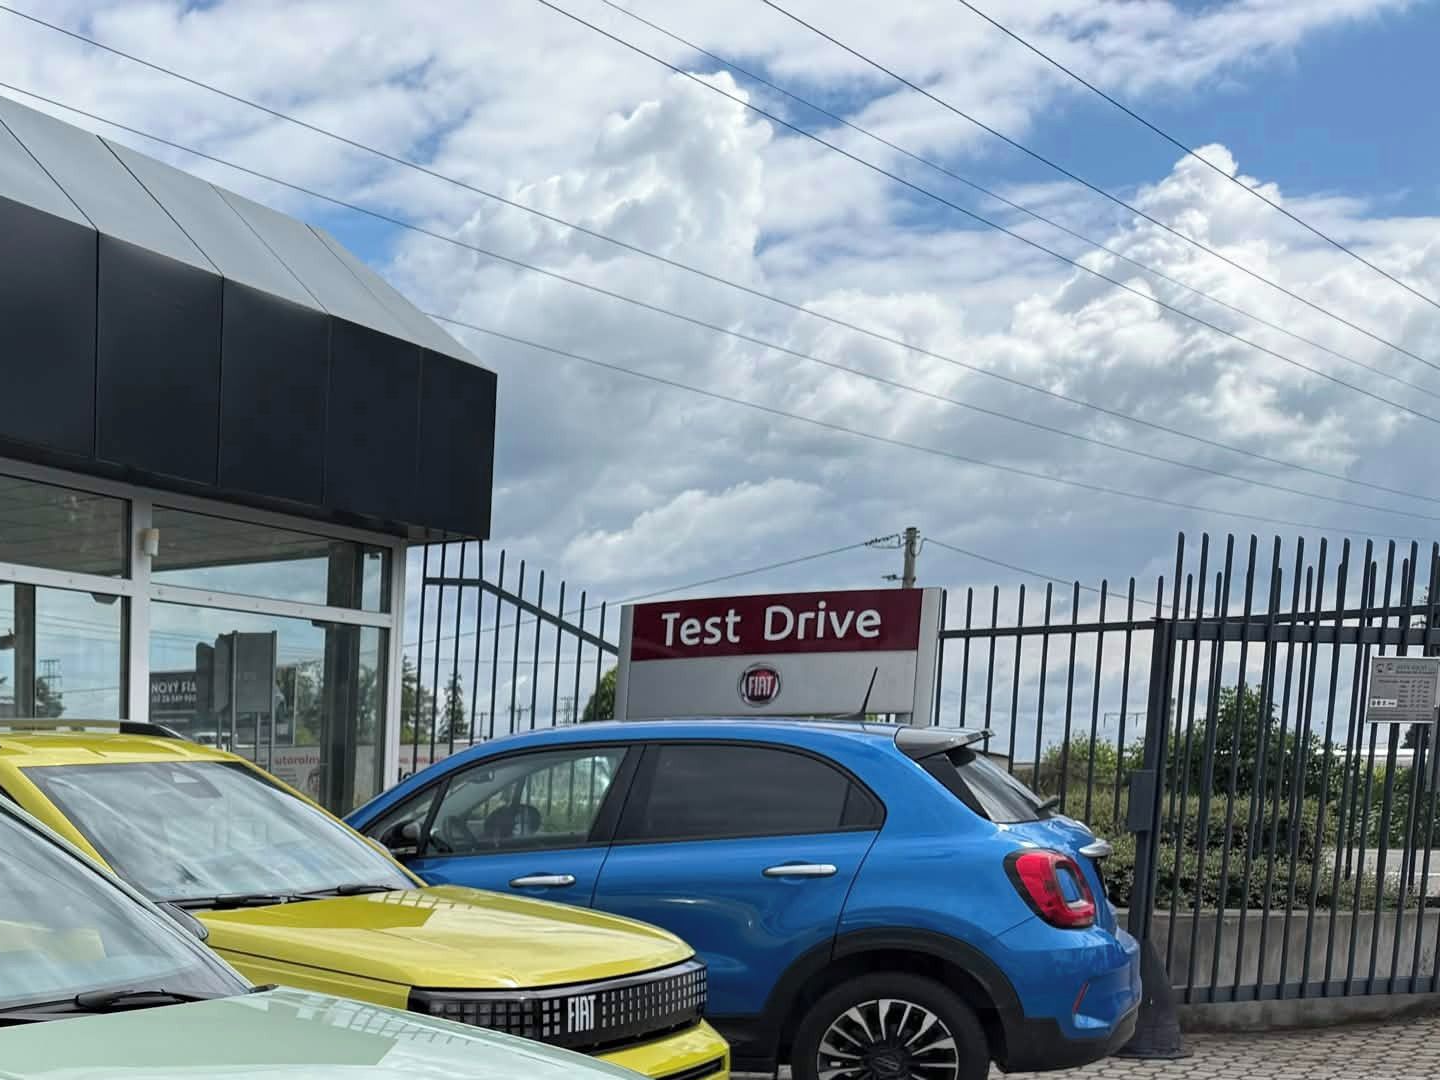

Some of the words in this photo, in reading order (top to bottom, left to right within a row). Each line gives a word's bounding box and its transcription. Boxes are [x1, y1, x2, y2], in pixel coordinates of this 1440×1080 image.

[661, 608, 743, 648] Test
[763, 600, 883, 642] Drive
[181, 680, 197, 692] FIA
[748, 676, 774, 697] FIAT
[566, 994, 597, 1033] FIAT
